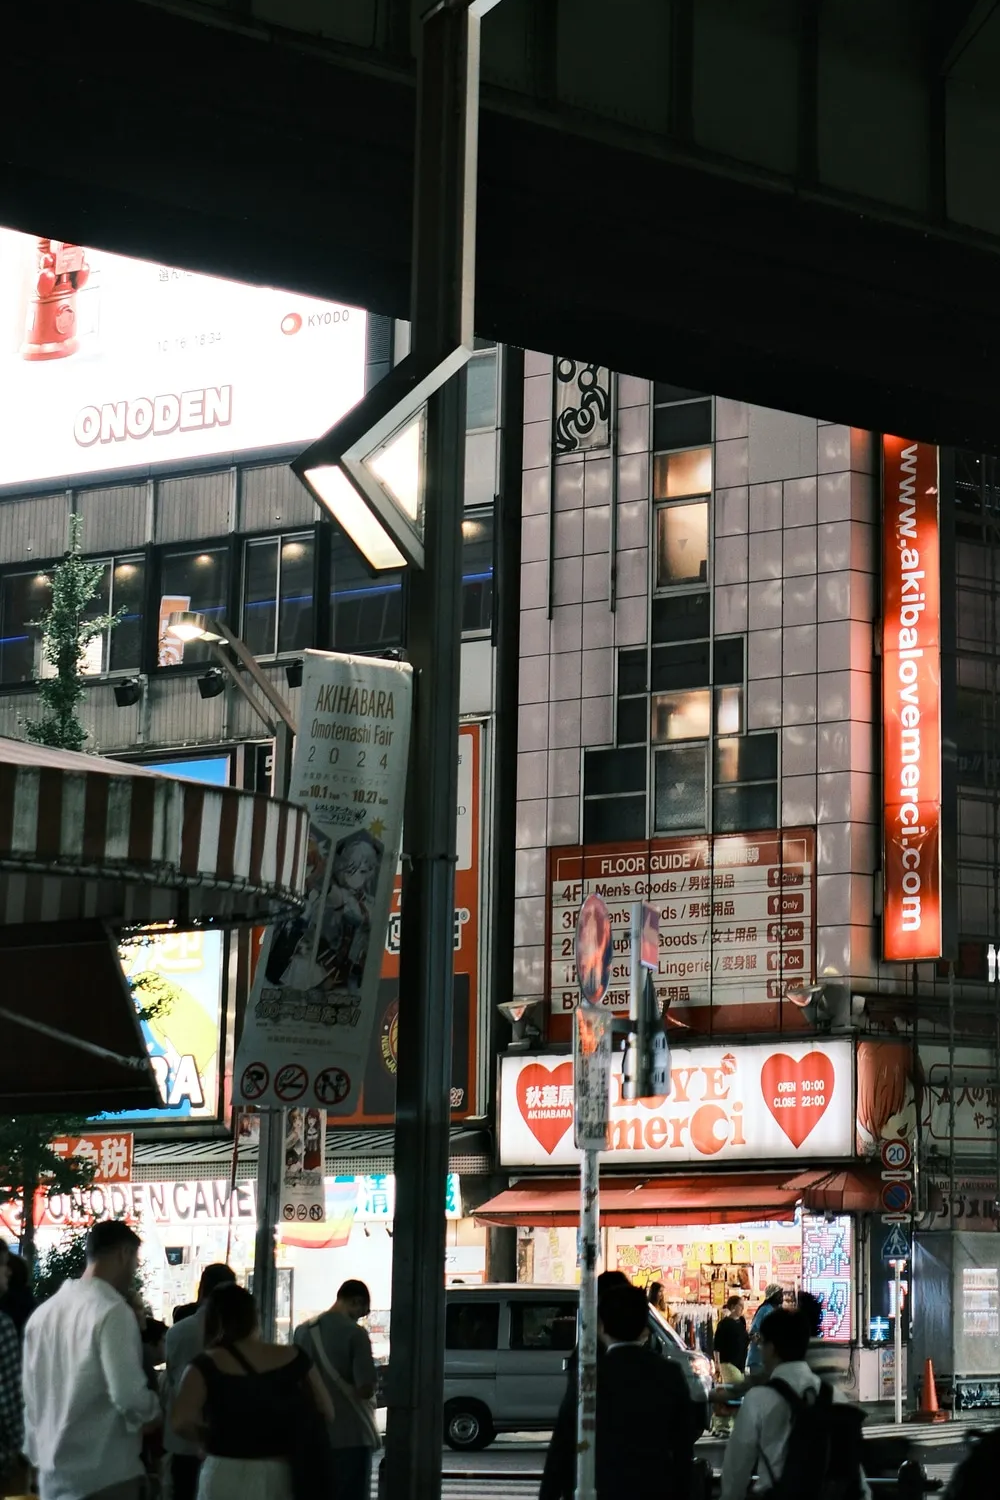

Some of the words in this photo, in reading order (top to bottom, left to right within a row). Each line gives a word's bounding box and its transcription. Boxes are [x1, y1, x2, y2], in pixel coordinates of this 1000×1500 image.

[307, 309, 351, 328] KYODO
[73, 385, 233, 448] ONODEN
[898, 443, 925, 932] www.akibalovemerci.com
[315, 684, 394, 719] AKIHABARA
[311, 718, 371, 744] Omotenashi
[374, 725, 394, 746] Fair
[352, 789, 378, 804] 10.27
[601, 858, 645, 875] FLOOR
[649, 852, 691, 871] GUIDE
[562, 884, 582, 902] 4F
[595, 882, 631, 898] Men's
[634, 876, 677, 895] Goods
[689, 874, 735, 891] 男性用品
[609, 909, 631, 924] en's
[689, 900, 735, 918] 男性用品
[782, 900, 799, 910] Only
[787, 928, 801, 937] OK
[658, 959, 711, 977] Lingerie
[787, 955, 801, 965] OK
[602, 992, 631, 1006] etish
[381, 1035, 391, 1059] NEW
[525, 1084, 574, 1108] 秋葉原
[778, 1082, 797, 1093] OPEN
[801, 1079, 825, 1092] 10:00
[773, 1097, 797, 1108] CLOSE
[801, 1094, 825, 1107] 22:00
[527, 1109, 572, 1120] AKIHABARA
[888, 1146, 905, 1162] 20
